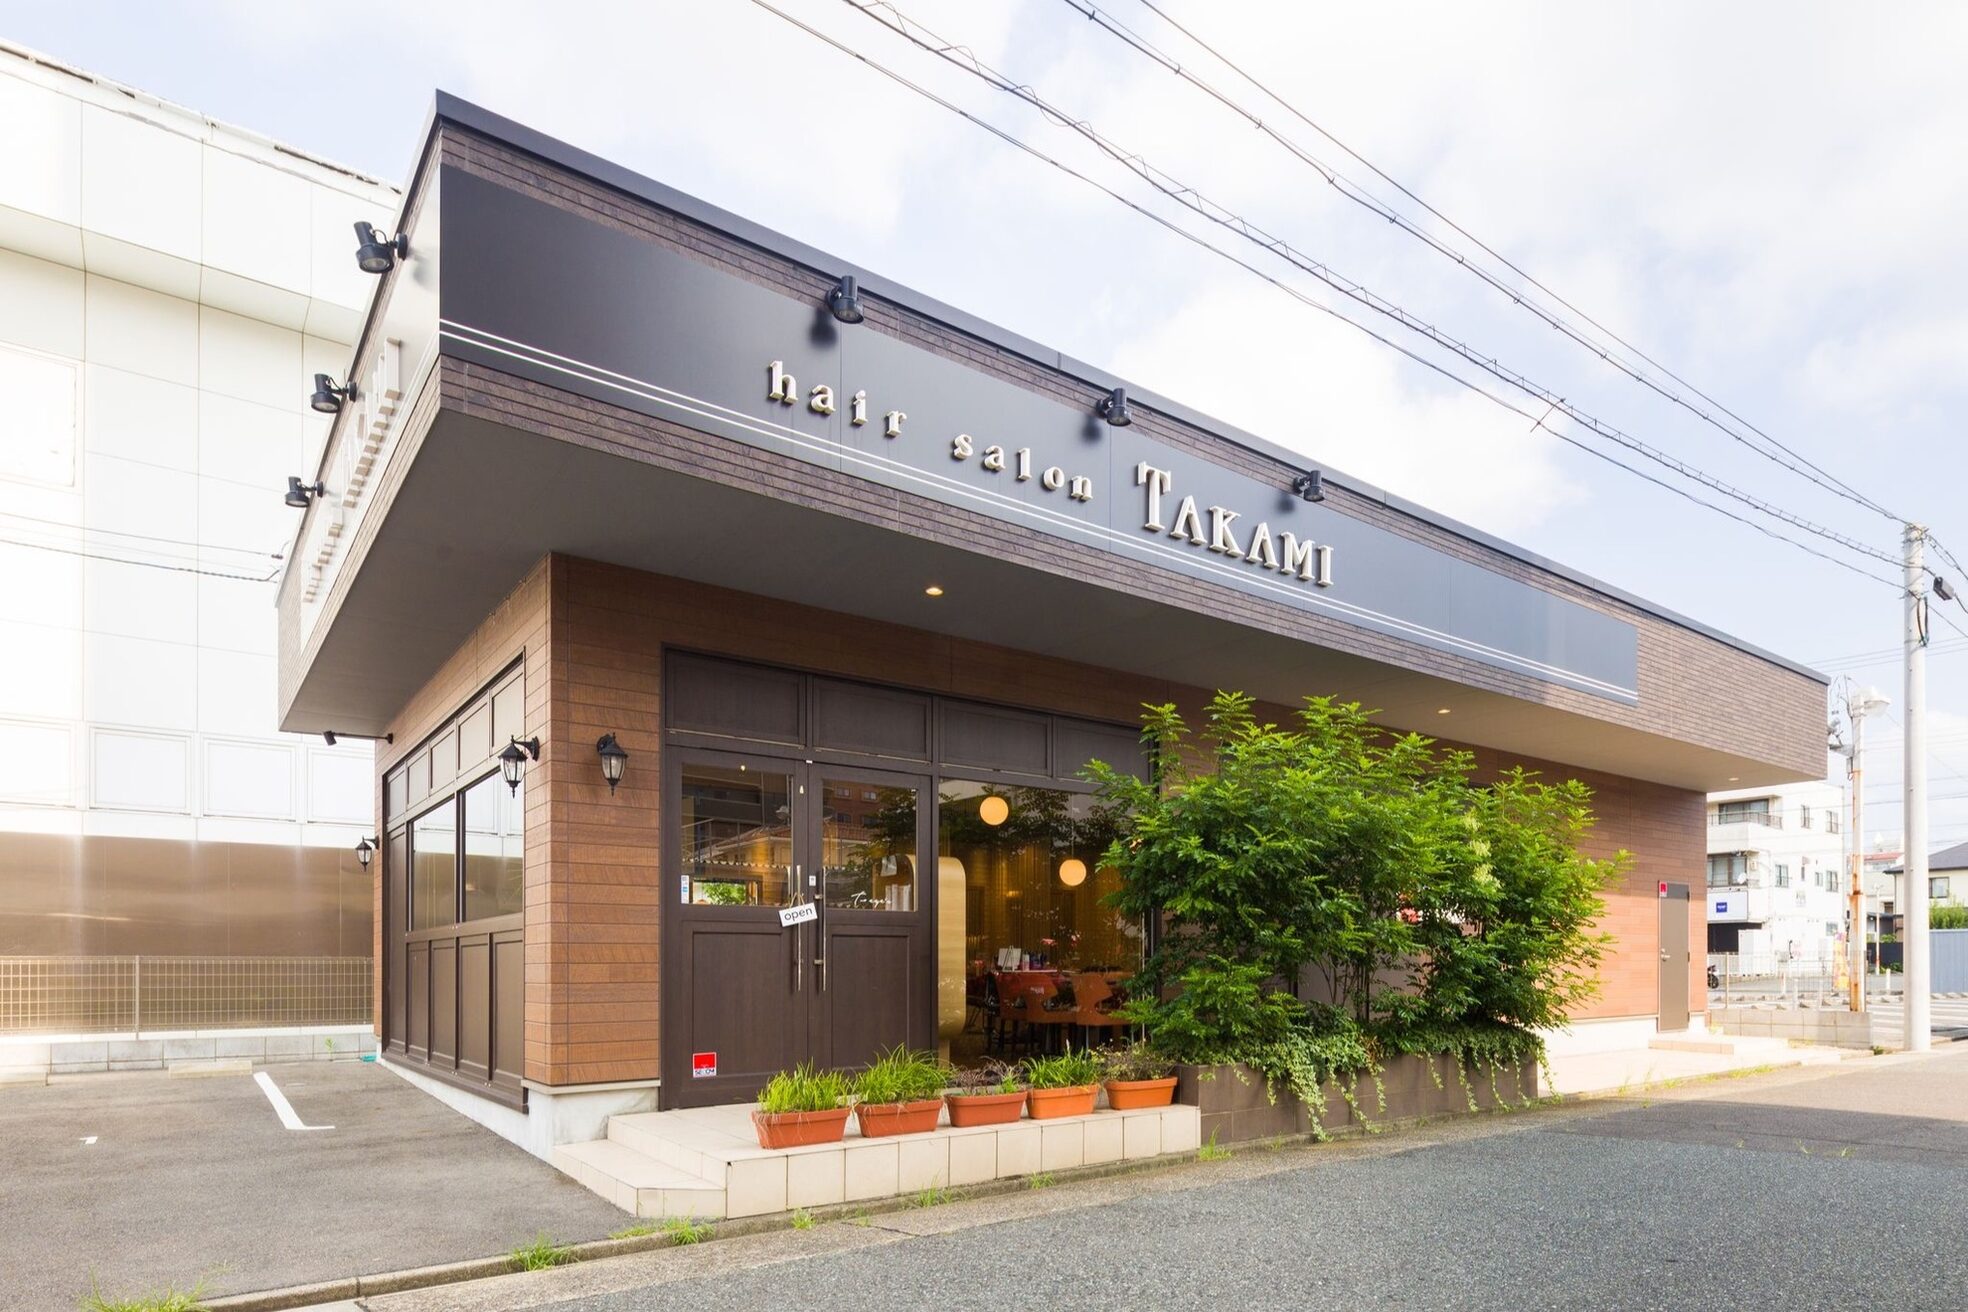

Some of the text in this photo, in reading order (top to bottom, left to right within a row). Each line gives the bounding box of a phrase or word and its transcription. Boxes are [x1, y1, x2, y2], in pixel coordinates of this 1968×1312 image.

[768, 359, 1334, 587] hair salon TAKAMI
[784, 907, 813, 922] open
